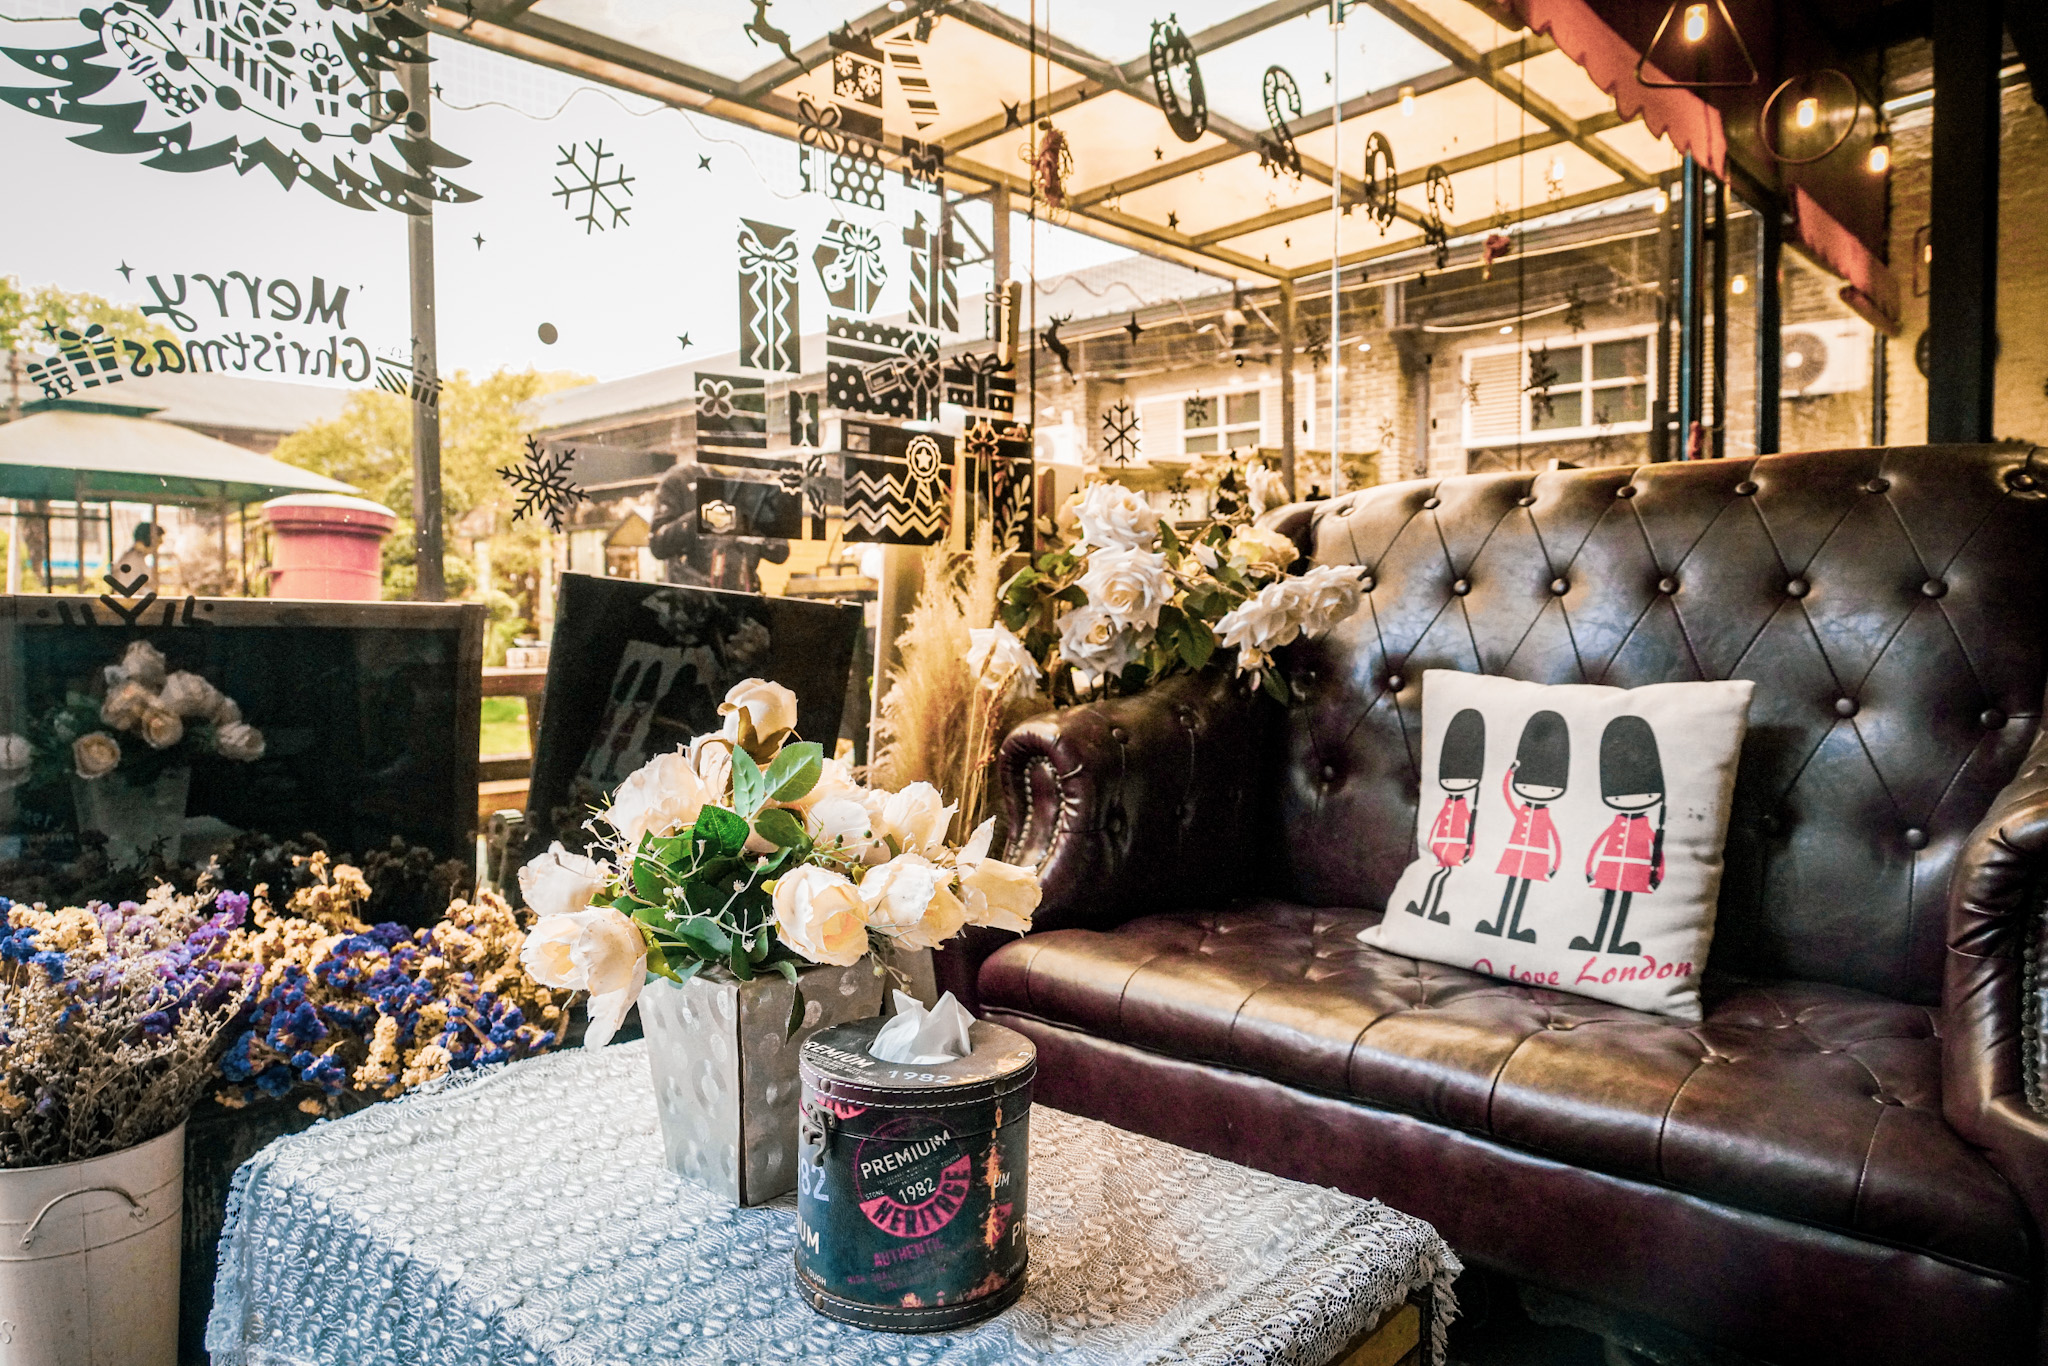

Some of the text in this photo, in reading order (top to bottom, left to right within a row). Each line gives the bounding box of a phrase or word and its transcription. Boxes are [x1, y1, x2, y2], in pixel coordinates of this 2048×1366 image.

[1575, 955, 1693, 986] London
[887, 1069, 952, 1085] 1982
[860, 1129, 951, 1180] PREMIUM
[865, 1188, 886, 1200] STONE
[871, 1169, 970, 1236] HERITAGE
[898, 1177, 937, 1205] 1982
[806, 1265, 827, 1287] TOUGH
